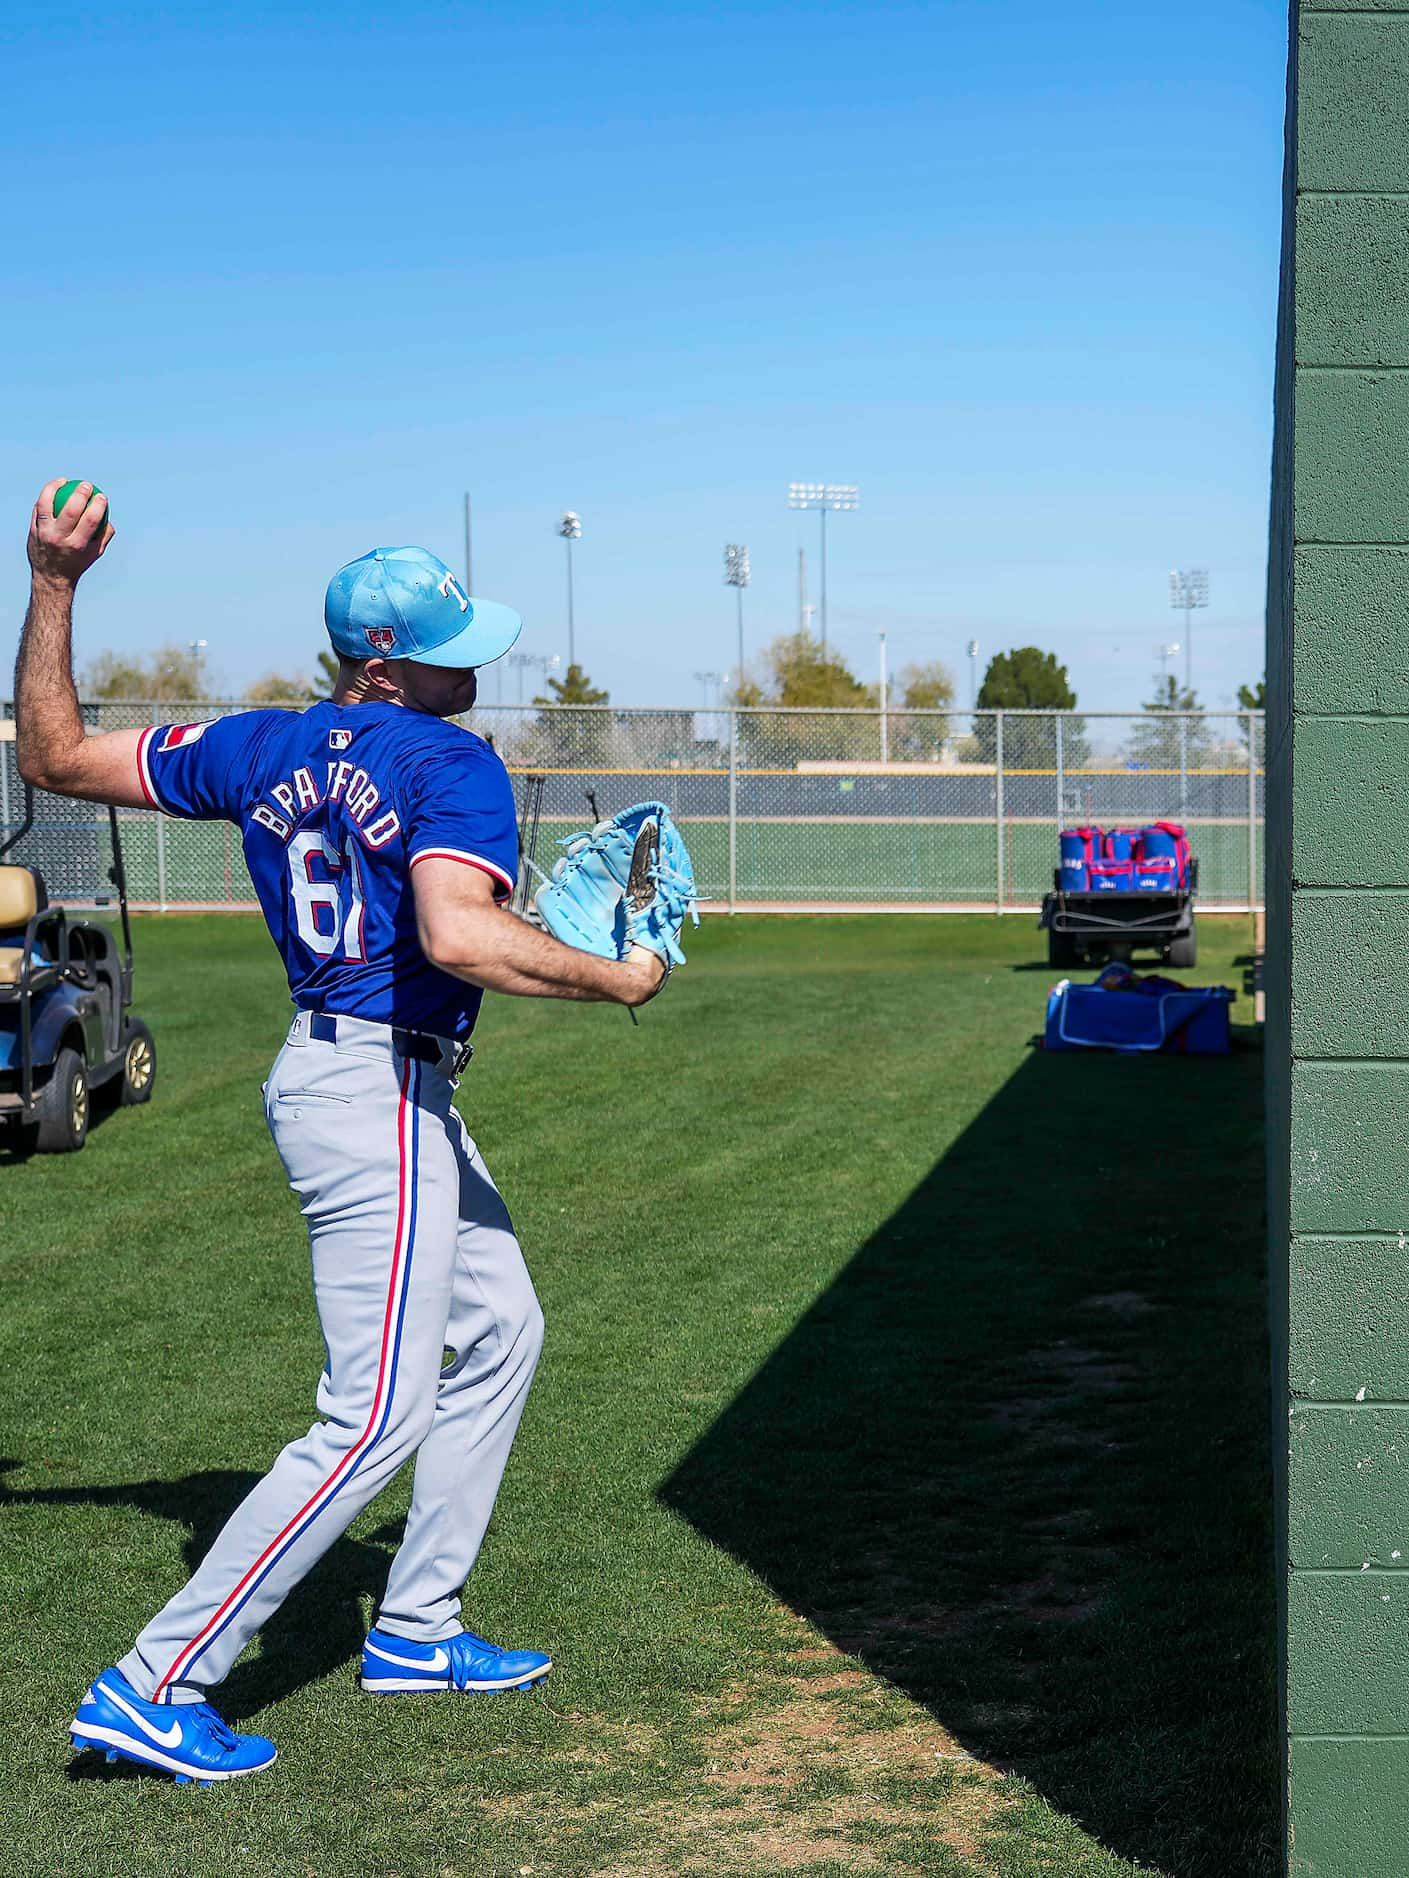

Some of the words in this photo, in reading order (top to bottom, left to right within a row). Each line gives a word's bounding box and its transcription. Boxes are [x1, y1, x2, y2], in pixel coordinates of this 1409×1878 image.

[437, 571, 469, 613] T
[251, 759, 401, 850] BRAFORD
[286, 829, 369, 964] 61
